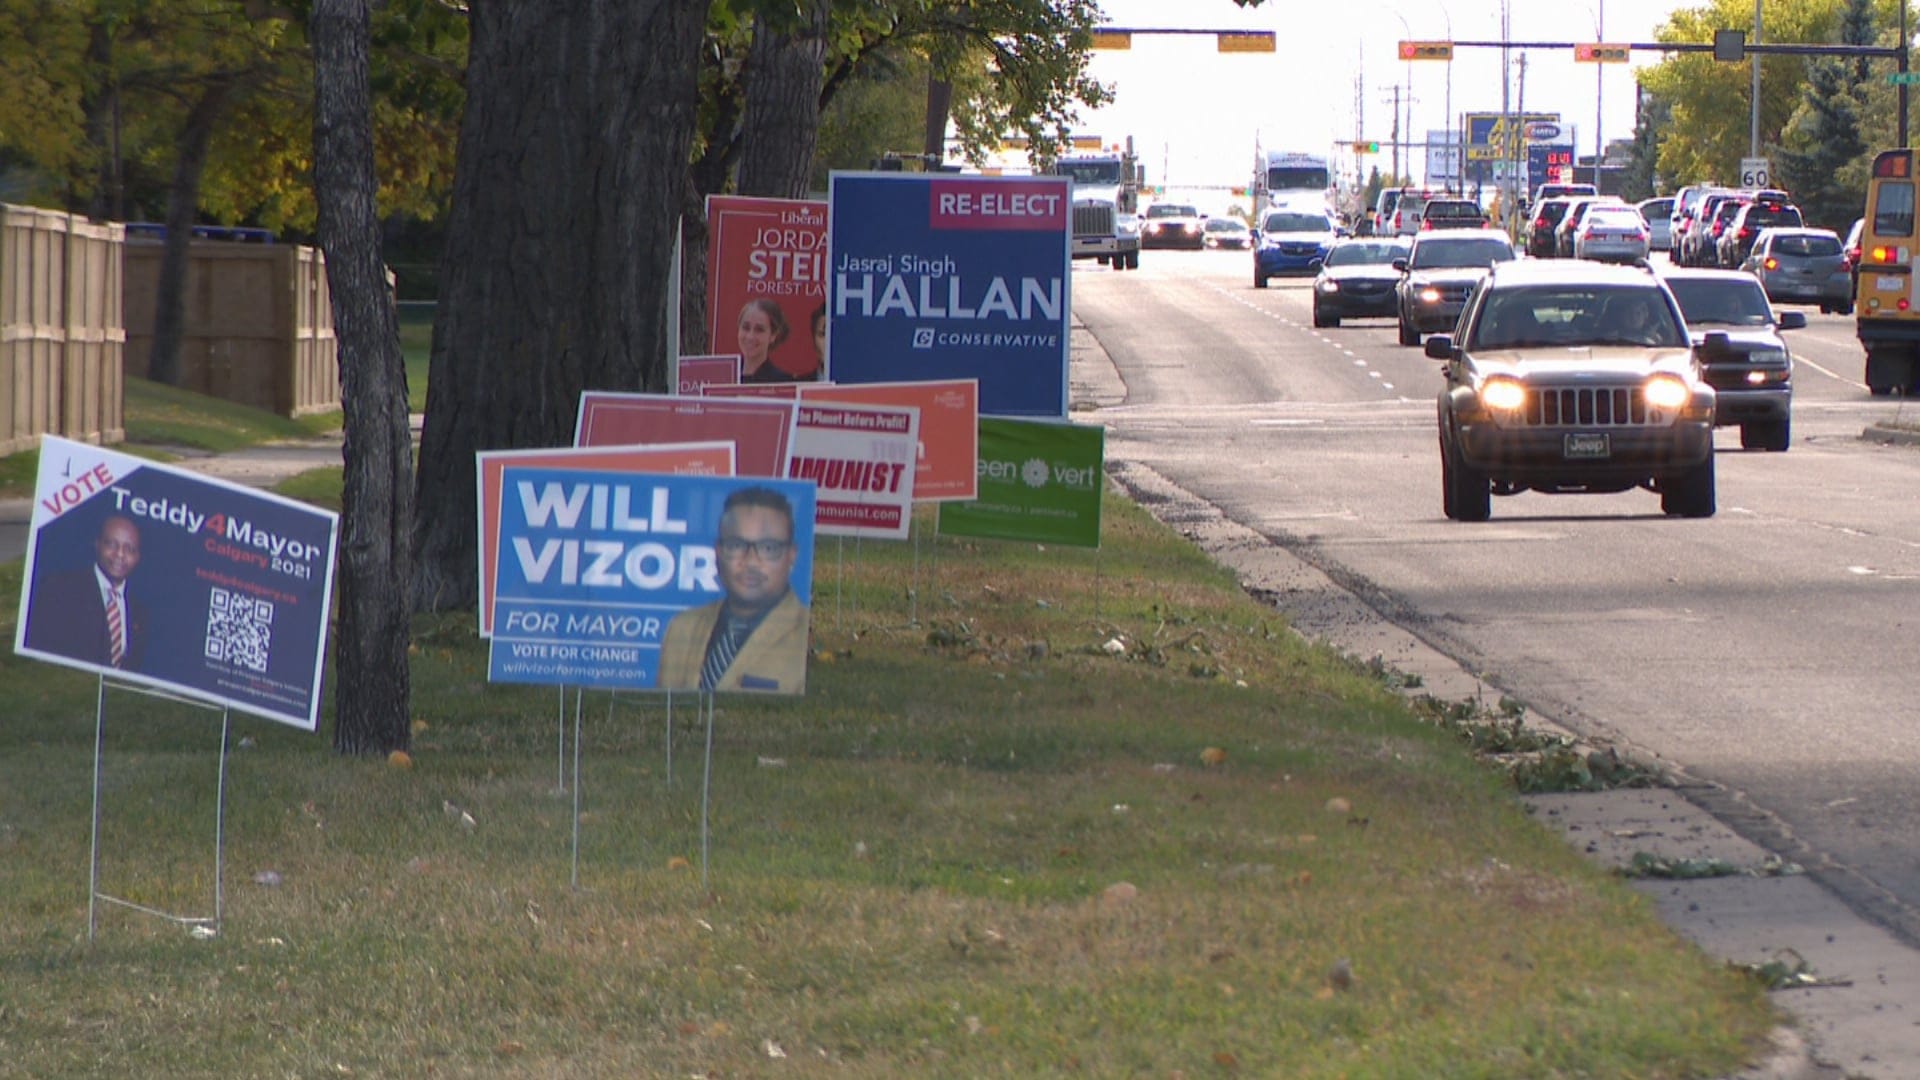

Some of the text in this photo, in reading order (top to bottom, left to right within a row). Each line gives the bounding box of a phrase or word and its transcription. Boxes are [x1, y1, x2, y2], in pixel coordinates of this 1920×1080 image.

[1743, 170, 1767, 187] 60
[939, 193, 1060, 217] RE-ELECT
[781, 210, 824, 225] Liberal
[751, 228, 828, 250] JORDA
[748, 250, 821, 282] STEI
[837, 253, 956, 278] Jasraj Singh
[747, 280, 802, 295] FOREST
[836, 273, 1062, 321] HALLAN
[938, 332, 1057, 347] CONSERVATIVE
[799, 409, 906, 429] he Planet Before Profit!
[1570, 439, 1604, 453] Jeep
[789, 456, 905, 493] MUNIST
[977, 459, 1094, 486] een vert
[42, 462, 114, 516] VOTE
[517, 480, 687, 534] WILL
[816, 505, 899, 521] mmunist.com
[111, 486, 321, 561] Teddy4Mayor
[204, 539, 311, 581] Calgary 2021
[512, 536, 720, 591] VIZOR
[506, 611, 660, 638] FOR MAYOR
[512, 643, 639, 663] VOTE FOR CHANGE
[502, 663, 647, 680] willvizorformayor.com
